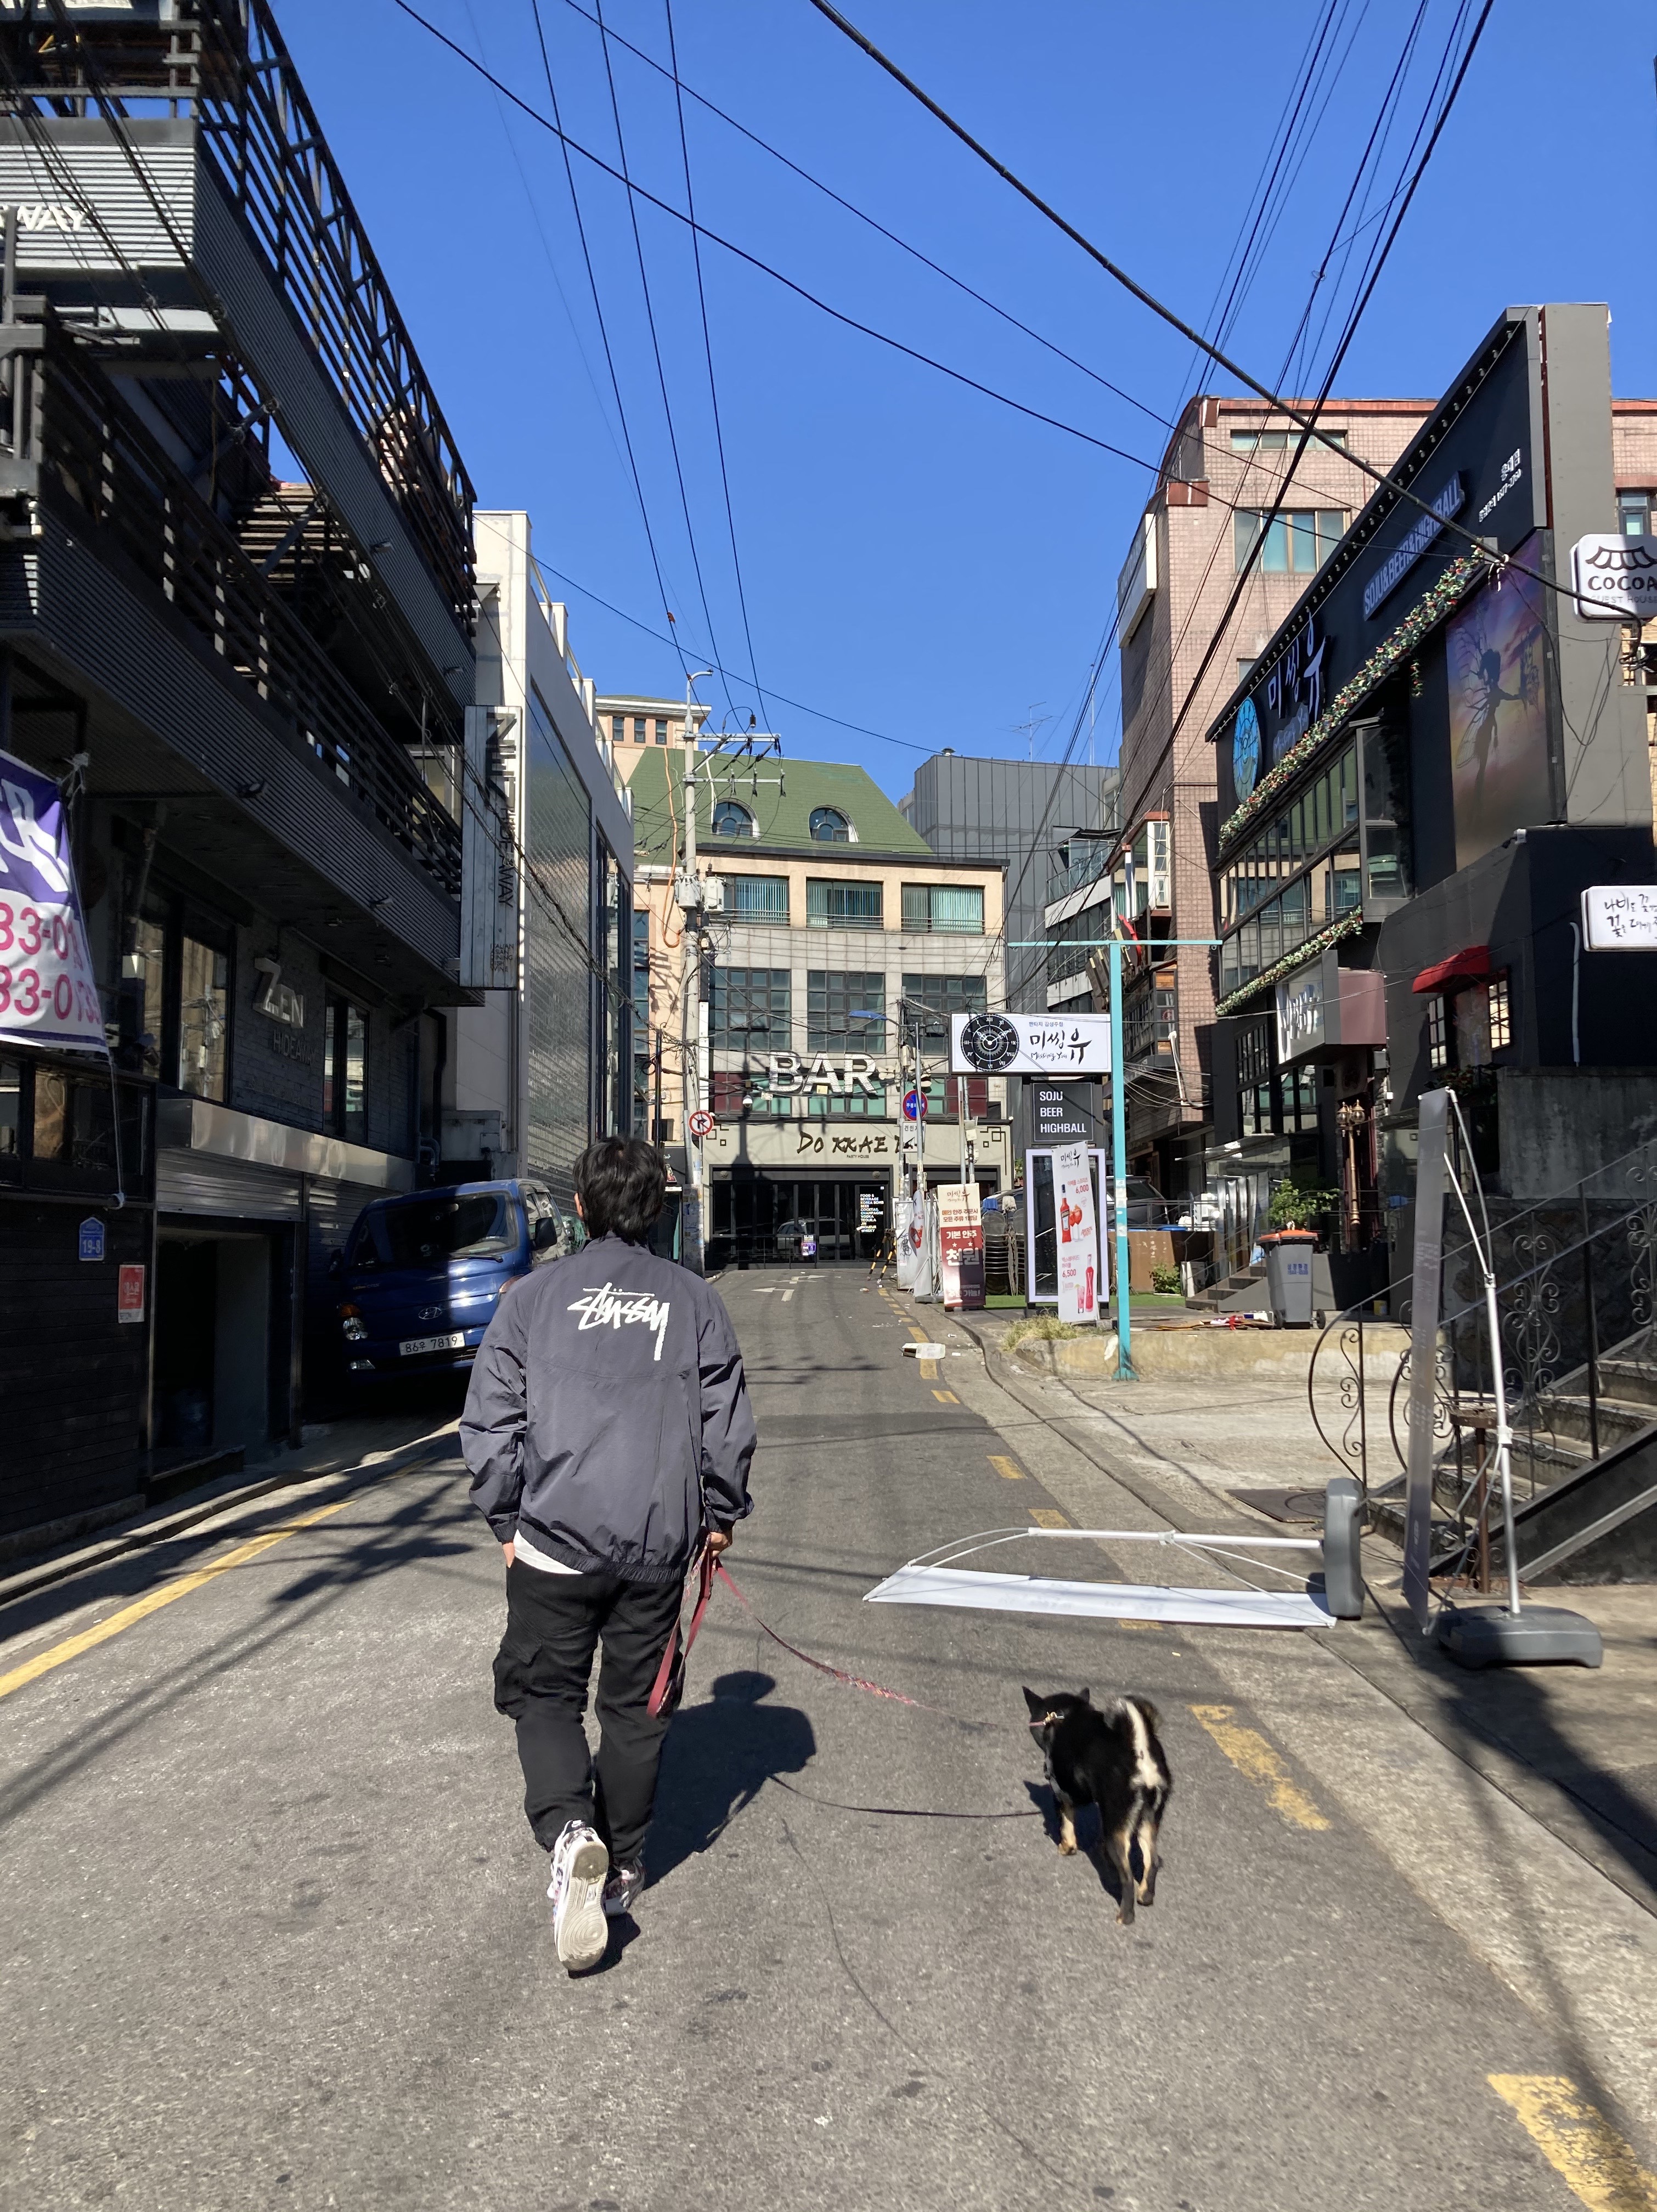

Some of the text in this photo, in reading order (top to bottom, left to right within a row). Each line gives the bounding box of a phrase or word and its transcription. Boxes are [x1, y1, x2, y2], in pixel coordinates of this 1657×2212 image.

[0, 205, 86, 232] WAY
[1587, 575, 1657, 591] COCOA
[252, 957, 304, 1028] ZEN
[1029, 1028, 1092, 1065] 미씽유
[1056, 1051, 1067, 1060] You
[769, 1050, 878, 1094] BAR
[1039, 1091, 1063, 1101] SOJU
[1040, 1107, 1063, 1117] BEER
[1040, 1123, 1087, 1133] HIGHBALL
[797, 1131, 824, 1154] DO
[1075, 1184, 1089, 1194] 6,000
[946, 1229, 977, 1239] 기본 안주
[945, 1247, 980, 1266] 천원
[1062, 1268, 1077, 1278] 6,500
[430, 1336, 458, 1349] 7819
